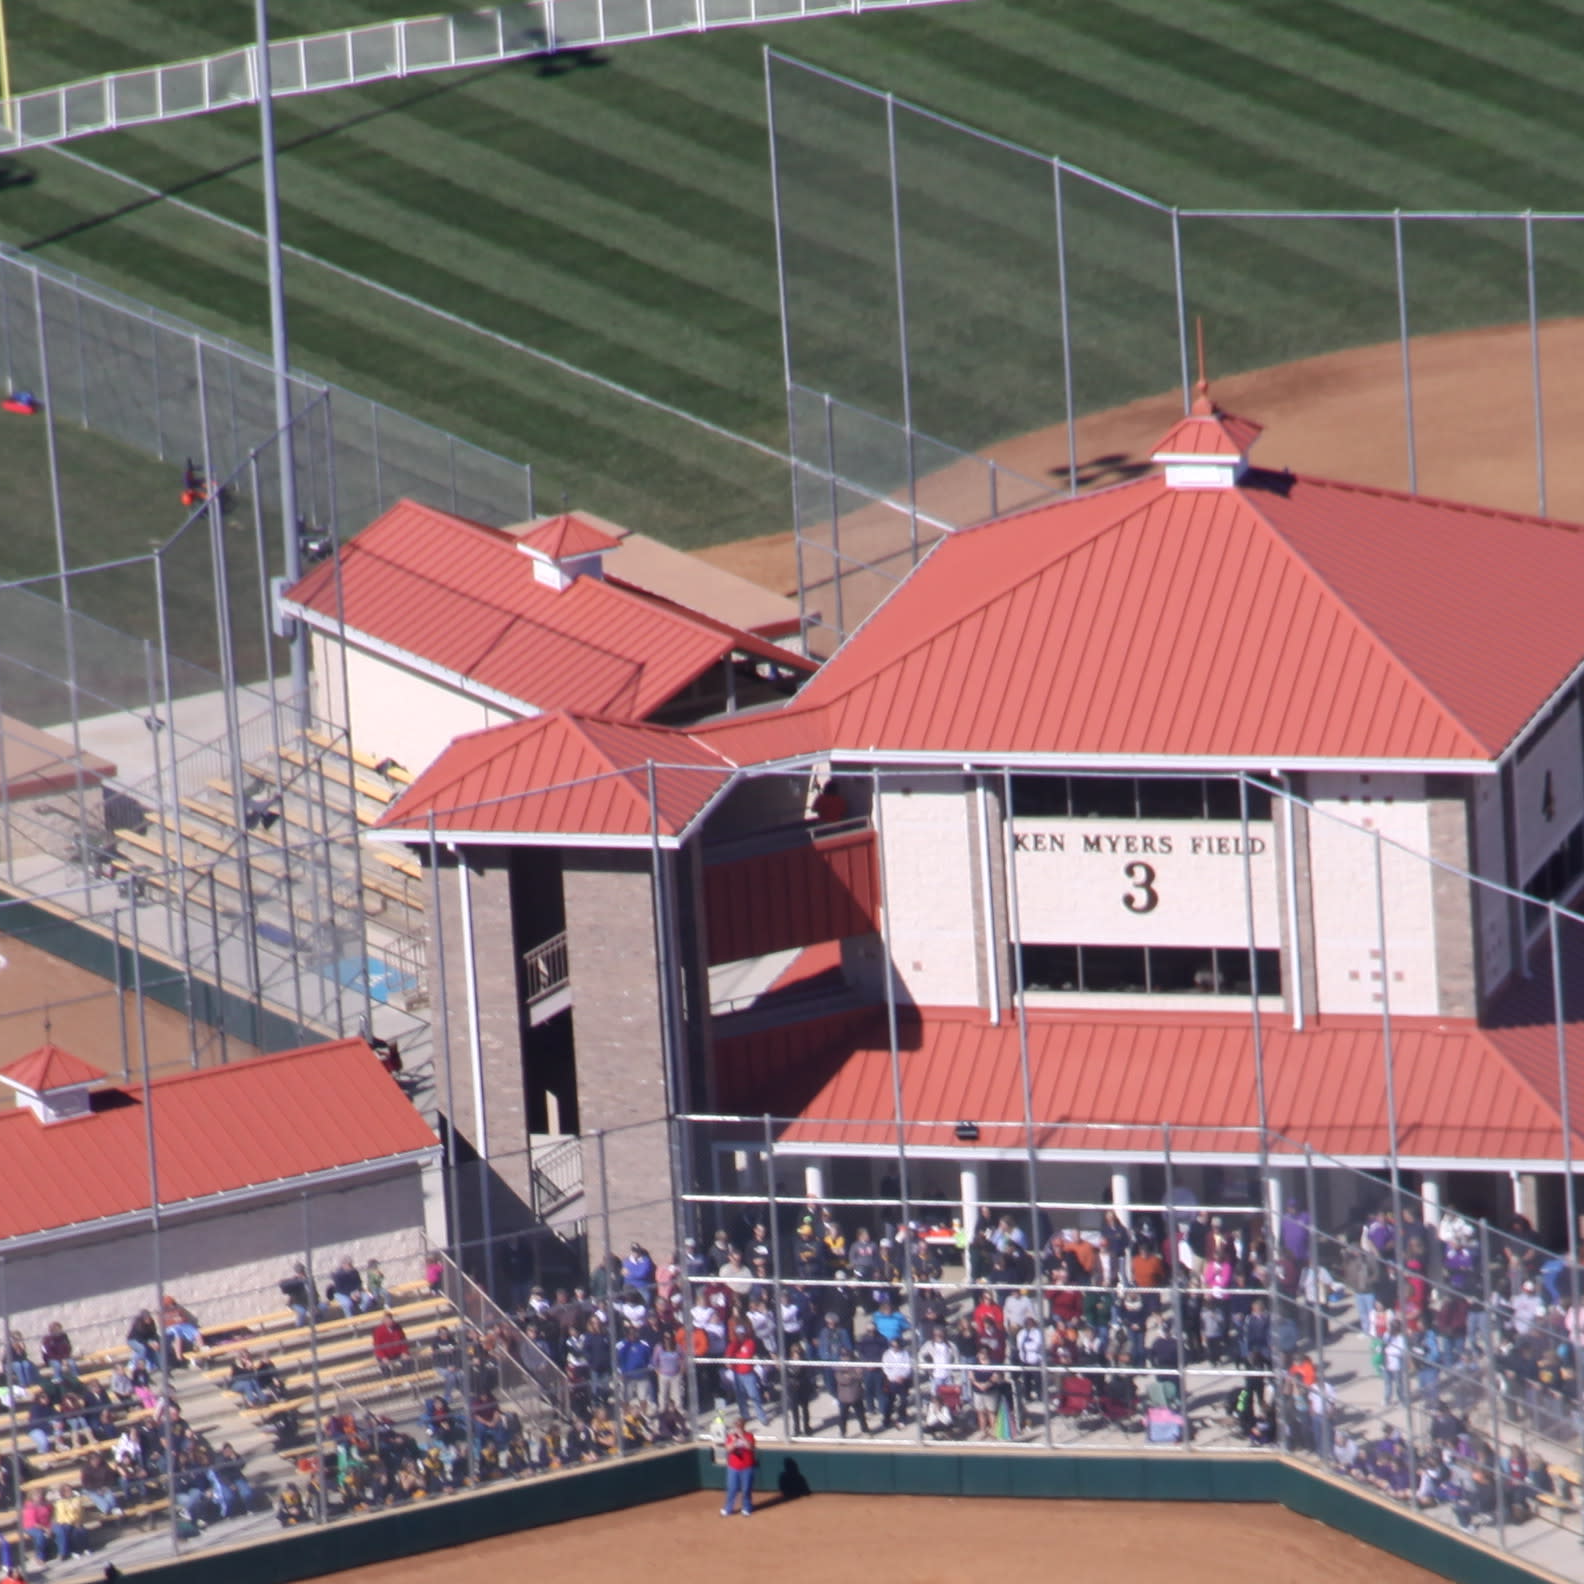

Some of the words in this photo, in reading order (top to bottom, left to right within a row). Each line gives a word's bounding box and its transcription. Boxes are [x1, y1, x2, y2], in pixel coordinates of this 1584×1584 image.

[1014, 833, 1065, 852] KEN
[1082, 834, 1173, 854] MYERS
[1191, 836, 1266, 855] FIELD
[1123, 861, 1159, 914] 3
